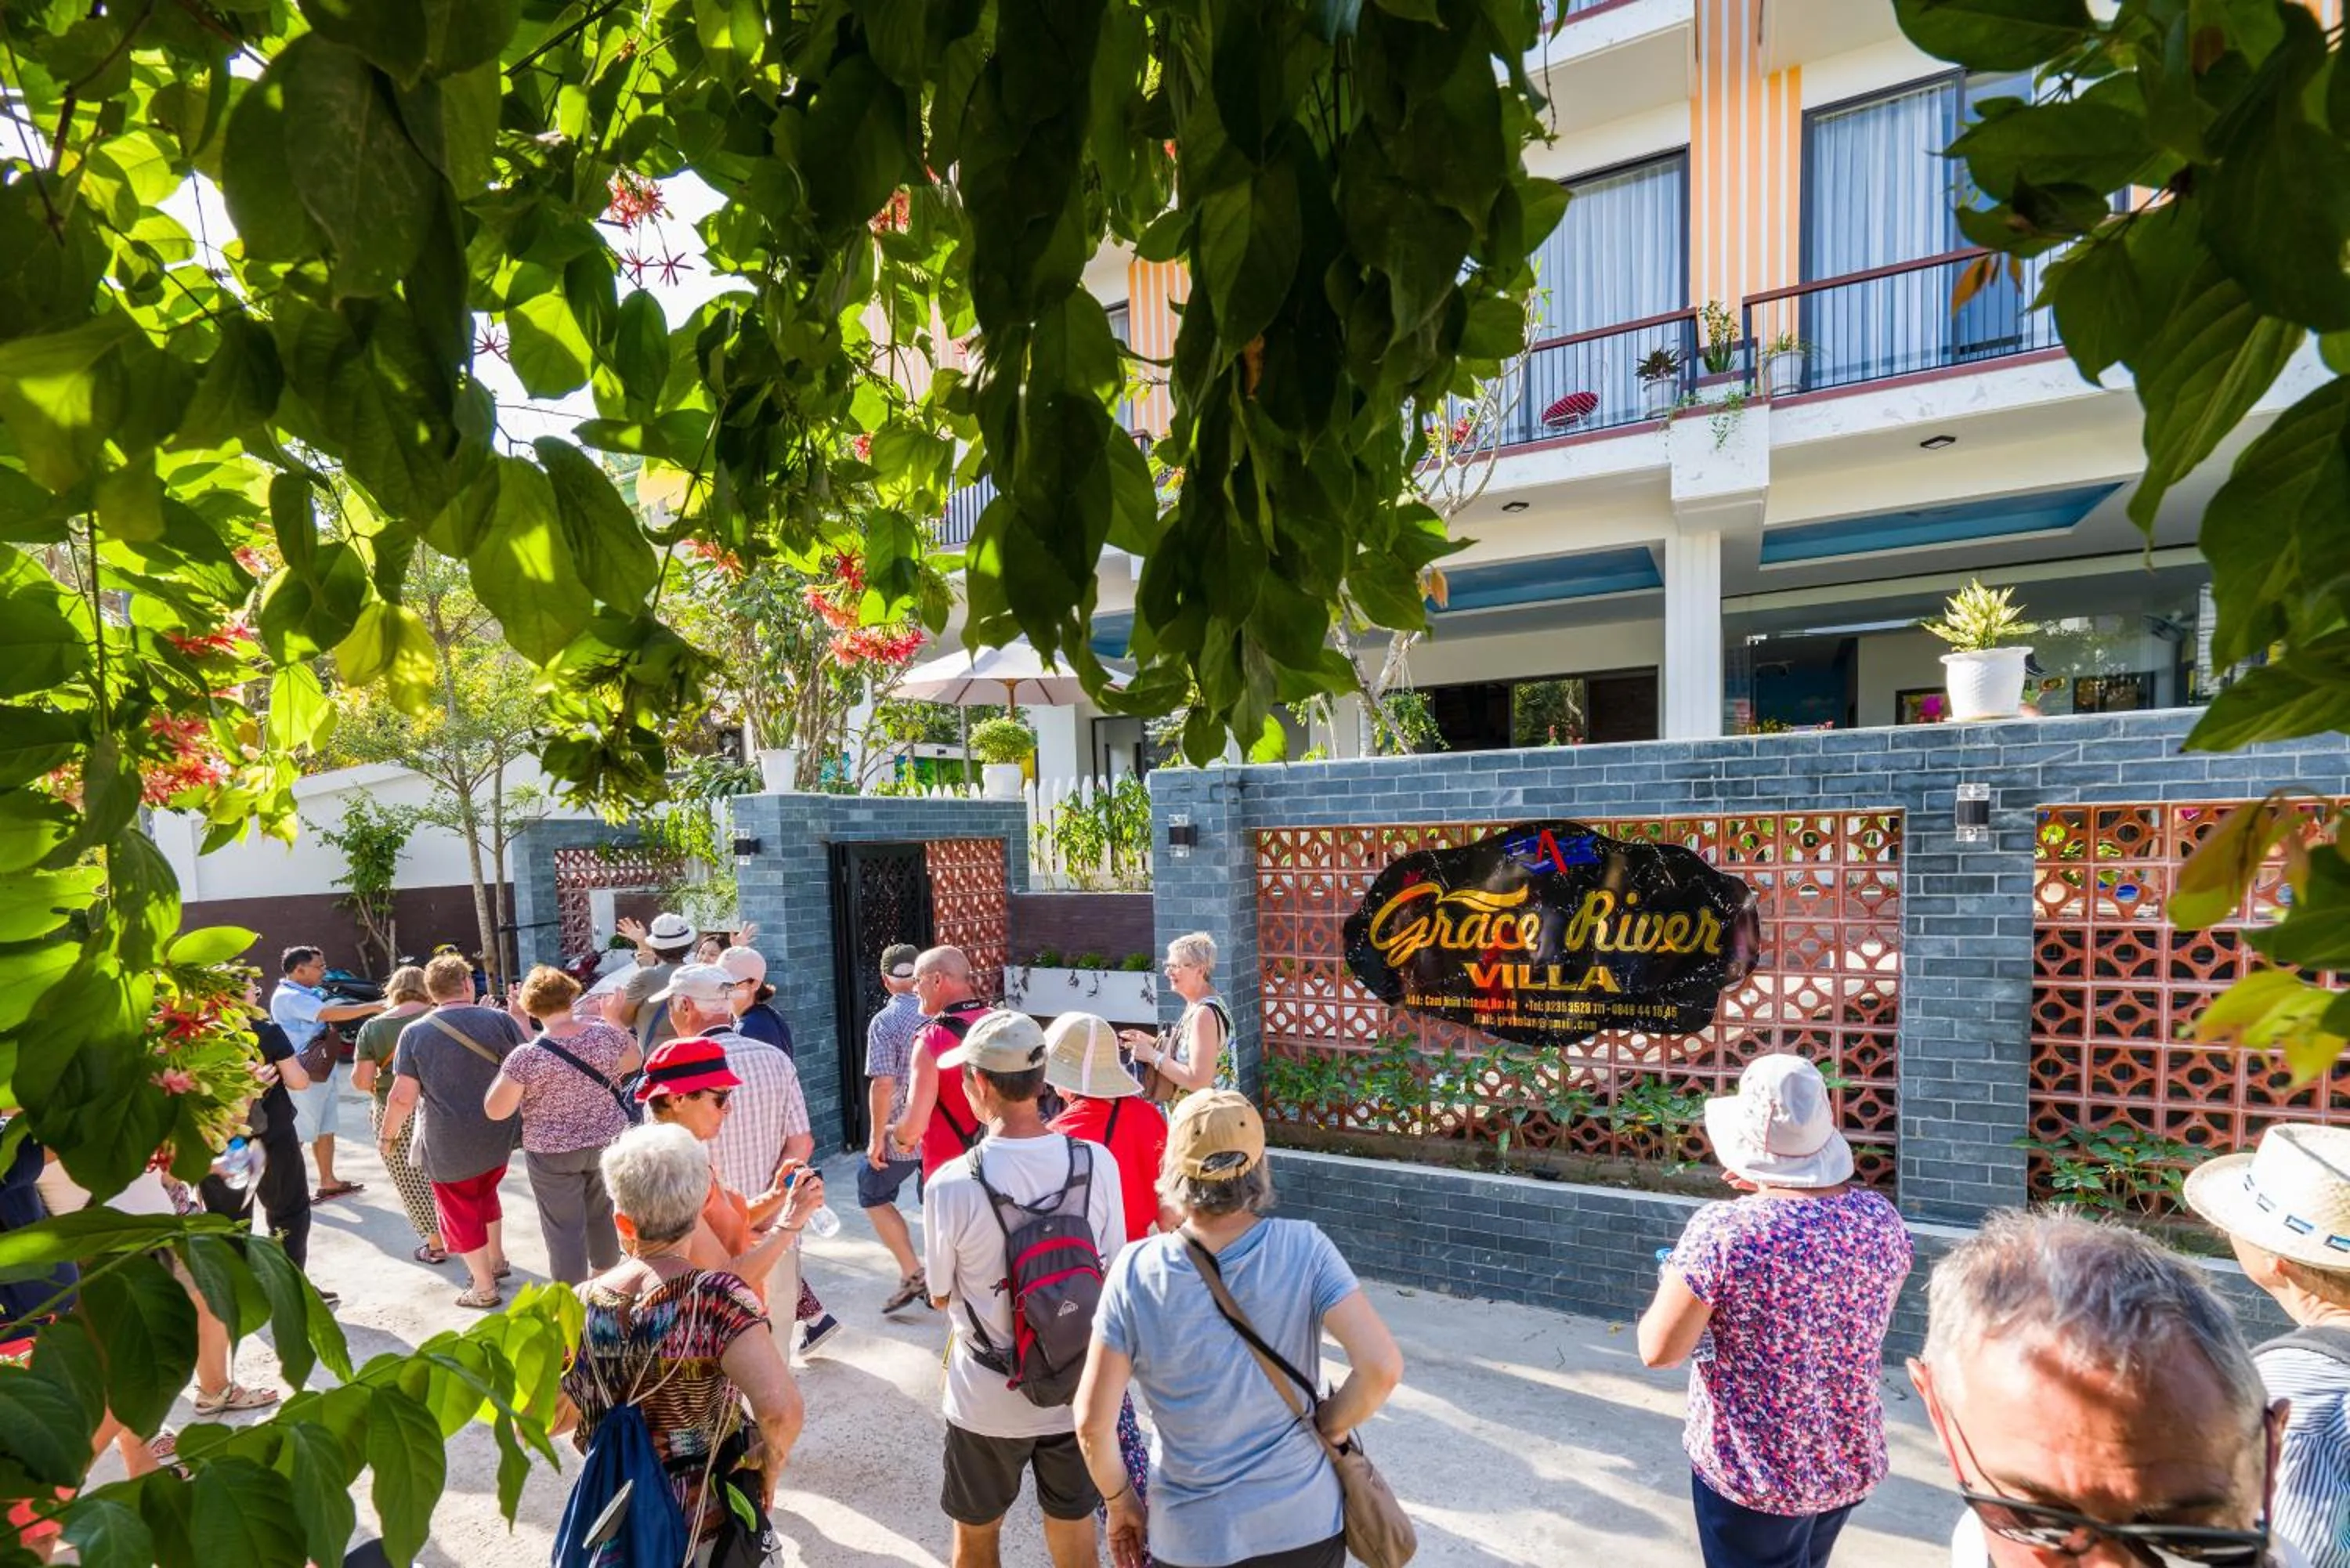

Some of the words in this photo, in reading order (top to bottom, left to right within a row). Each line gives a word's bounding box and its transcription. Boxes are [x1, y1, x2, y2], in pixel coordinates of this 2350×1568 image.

[1369, 882, 1540, 967] Grace
[1567, 888, 1723, 955] River
[1462, 962, 1621, 993] VILLA
